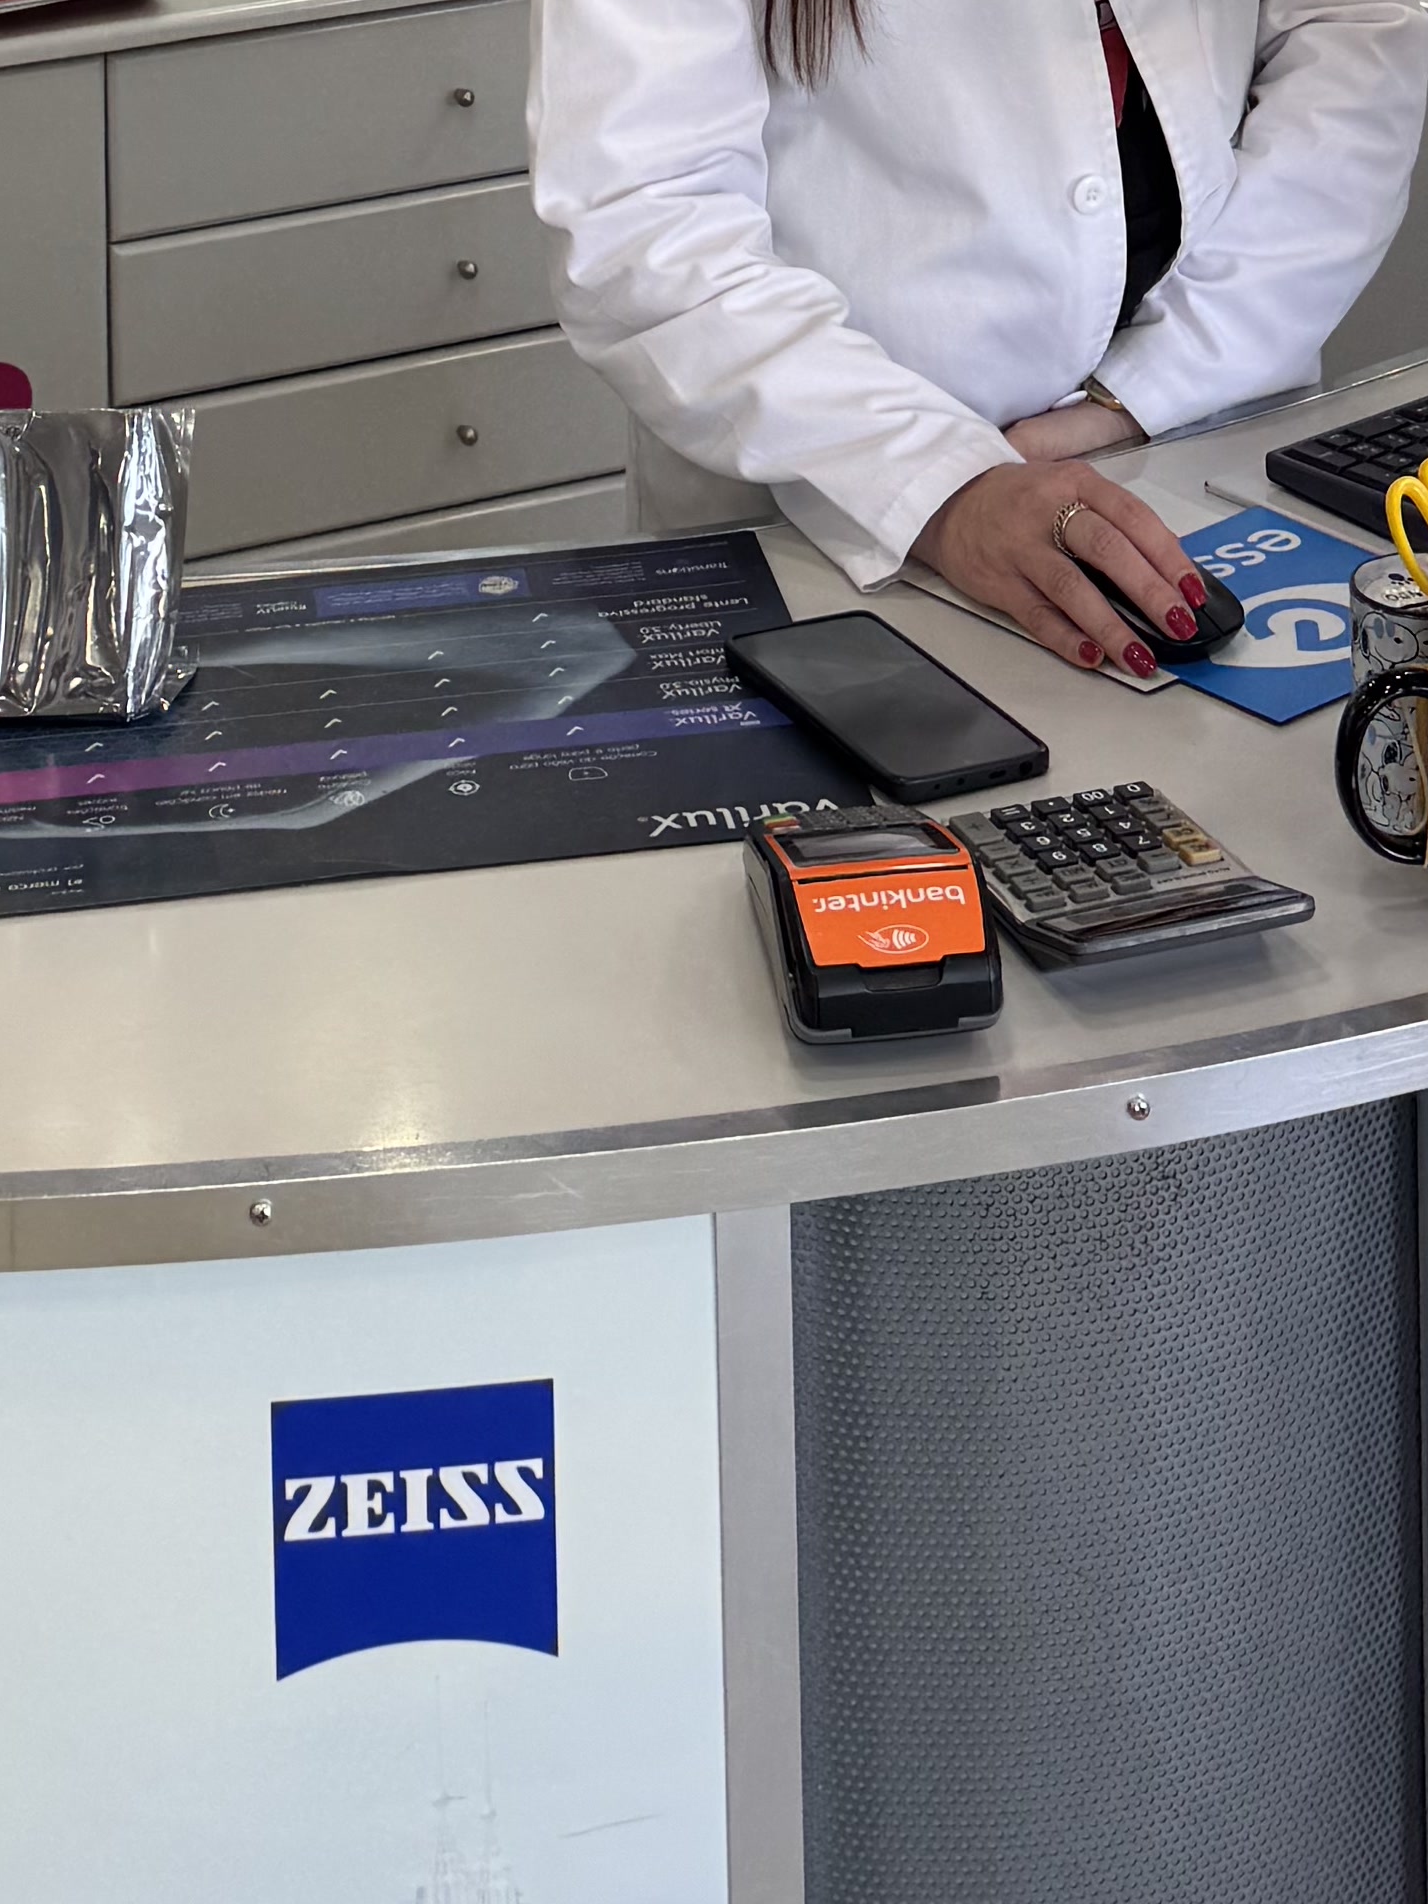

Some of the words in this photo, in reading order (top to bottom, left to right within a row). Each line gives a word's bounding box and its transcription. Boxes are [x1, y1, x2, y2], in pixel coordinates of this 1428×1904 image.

[633, 594, 708, 608] standard
[703, 597, 749, 608] Lente
[598, 603, 696, 618] progressiva
[813, 885, 966, 915] bankinter.
[283, 1457, 546, 1543] ZEISS
